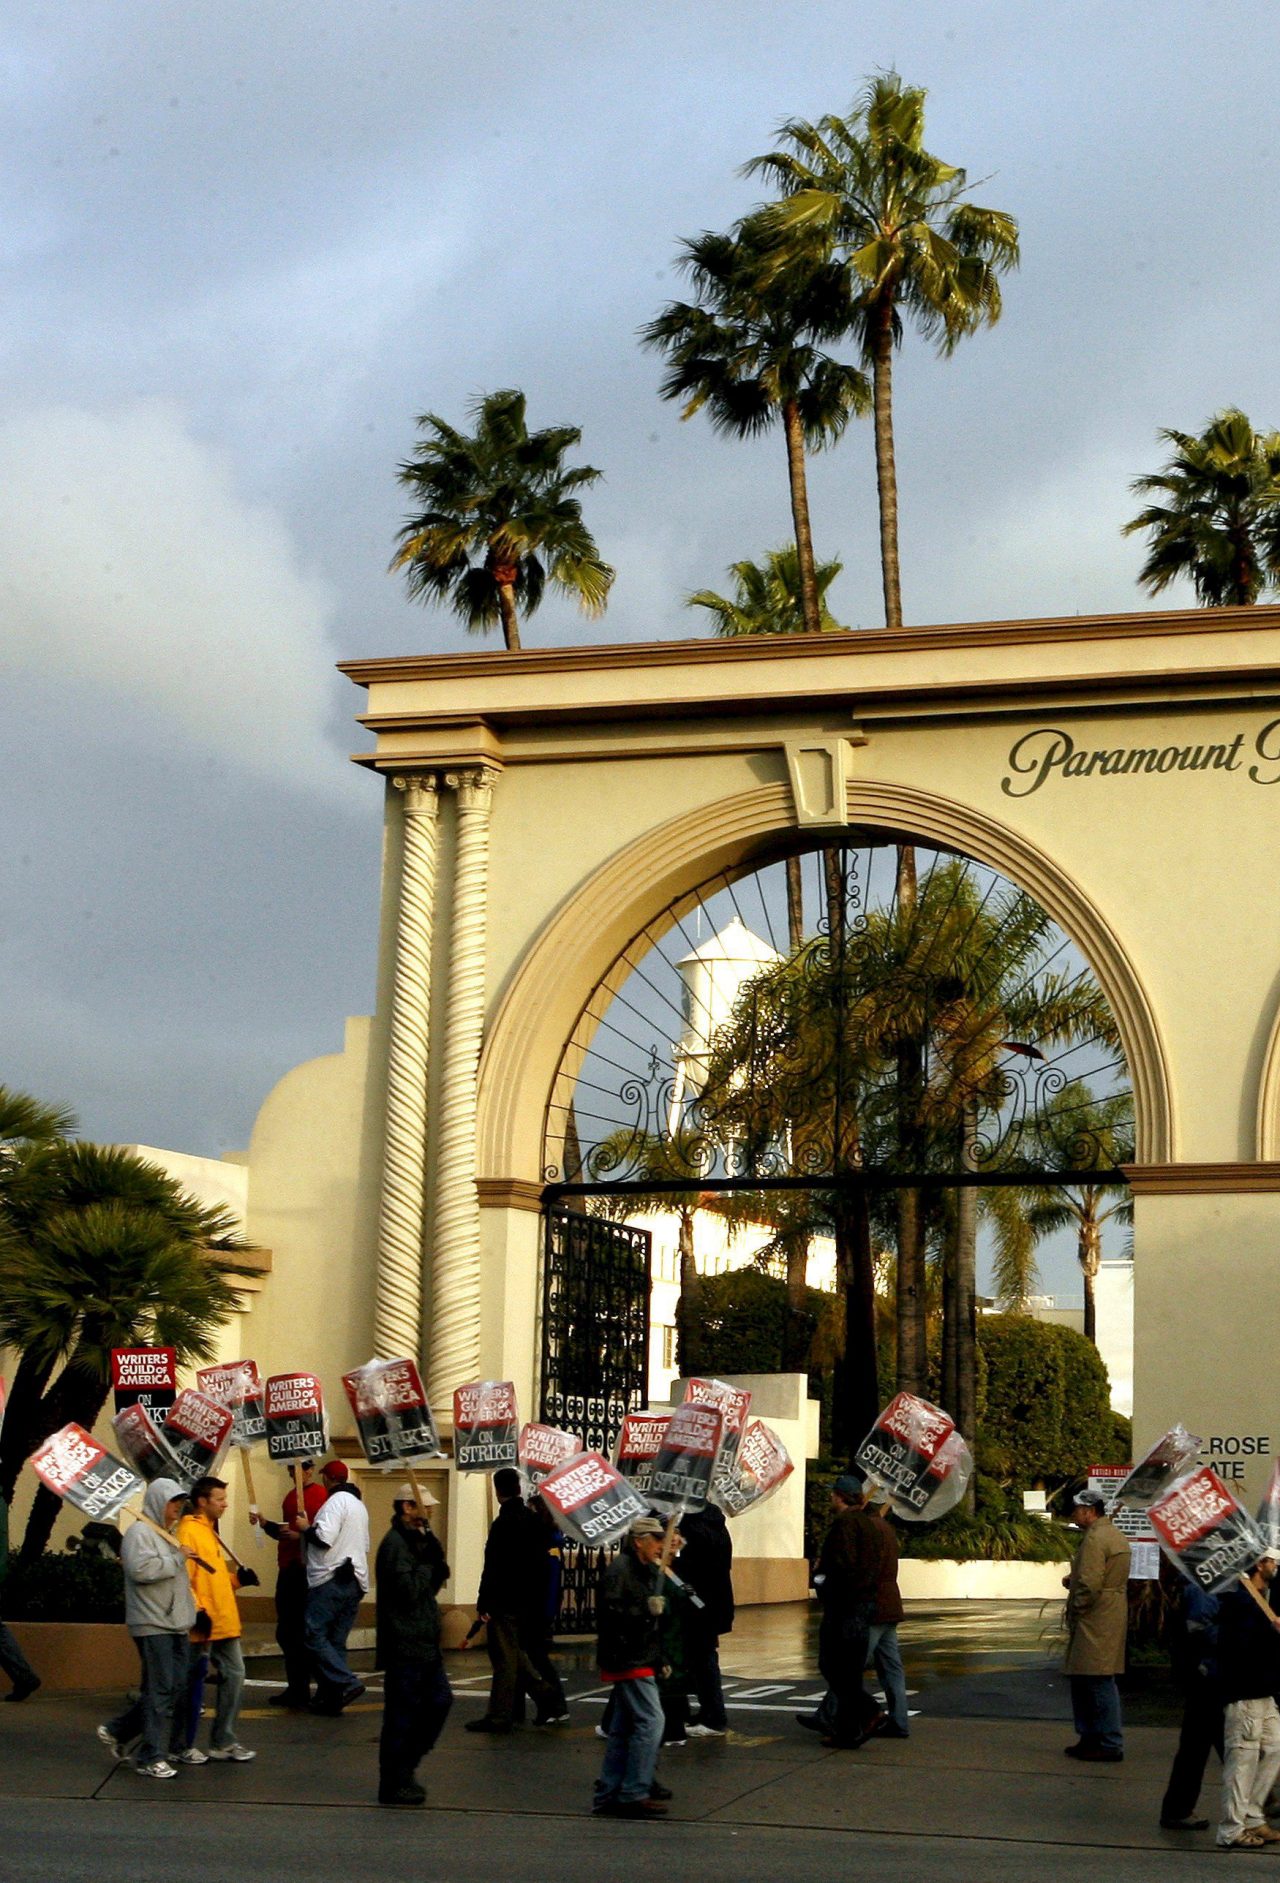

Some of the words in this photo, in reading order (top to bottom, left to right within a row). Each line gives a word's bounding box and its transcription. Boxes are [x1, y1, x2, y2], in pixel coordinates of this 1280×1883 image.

[1001, 729, 1245, 797] Paramount
[117, 1354, 168, 1365] WRITERS
[120, 1364, 155, 1375] GUILD
[155, 1367, 167, 1375] OF
[118, 1374, 171, 1385] AMERICA
[268, 1378, 315, 1392] WRITERS
[137, 1394, 152, 1406] ON
[270, 1390, 301, 1402] GUILD
[302, 1389, 314, 1398] OF
[182, 1393, 227, 1427] WRITERS
[268, 1398, 319, 1413] AMERICA
[179, 1405, 210, 1428] GUILD
[171, 1414, 218, 1447] AMERICA
[286, 1420, 299, 1432] ON
[628, 1422, 669, 1432] WRITE
[270, 1431, 323, 1453] STRIKE
[478, 1431, 493, 1443] ON
[628, 1433, 663, 1443] GUILD
[1201, 1437, 1270, 1455] ROSE
[459, 1443, 515, 1464] STRIKE
[526, 1439, 560, 1455] GUILD
[623, 1443, 660, 1454] AMERI
[519, 1450, 562, 1466] AMERIC
[861, 1444, 917, 1488] STRIKE
[544, 1459, 600, 1494] WRITERS
[1209, 1461, 1244, 1479] ATE
[81, 1467, 135, 1515] STRIKE
[555, 1475, 592, 1500] GUILD
[559, 1473, 616, 1509] AMERICA
[591, 1499, 610, 1514] ON
[1155, 1476, 1213, 1522] WRITERS
[1166, 1499, 1206, 1530] GUILD
[1172, 1496, 1232, 1545] AMERICA
